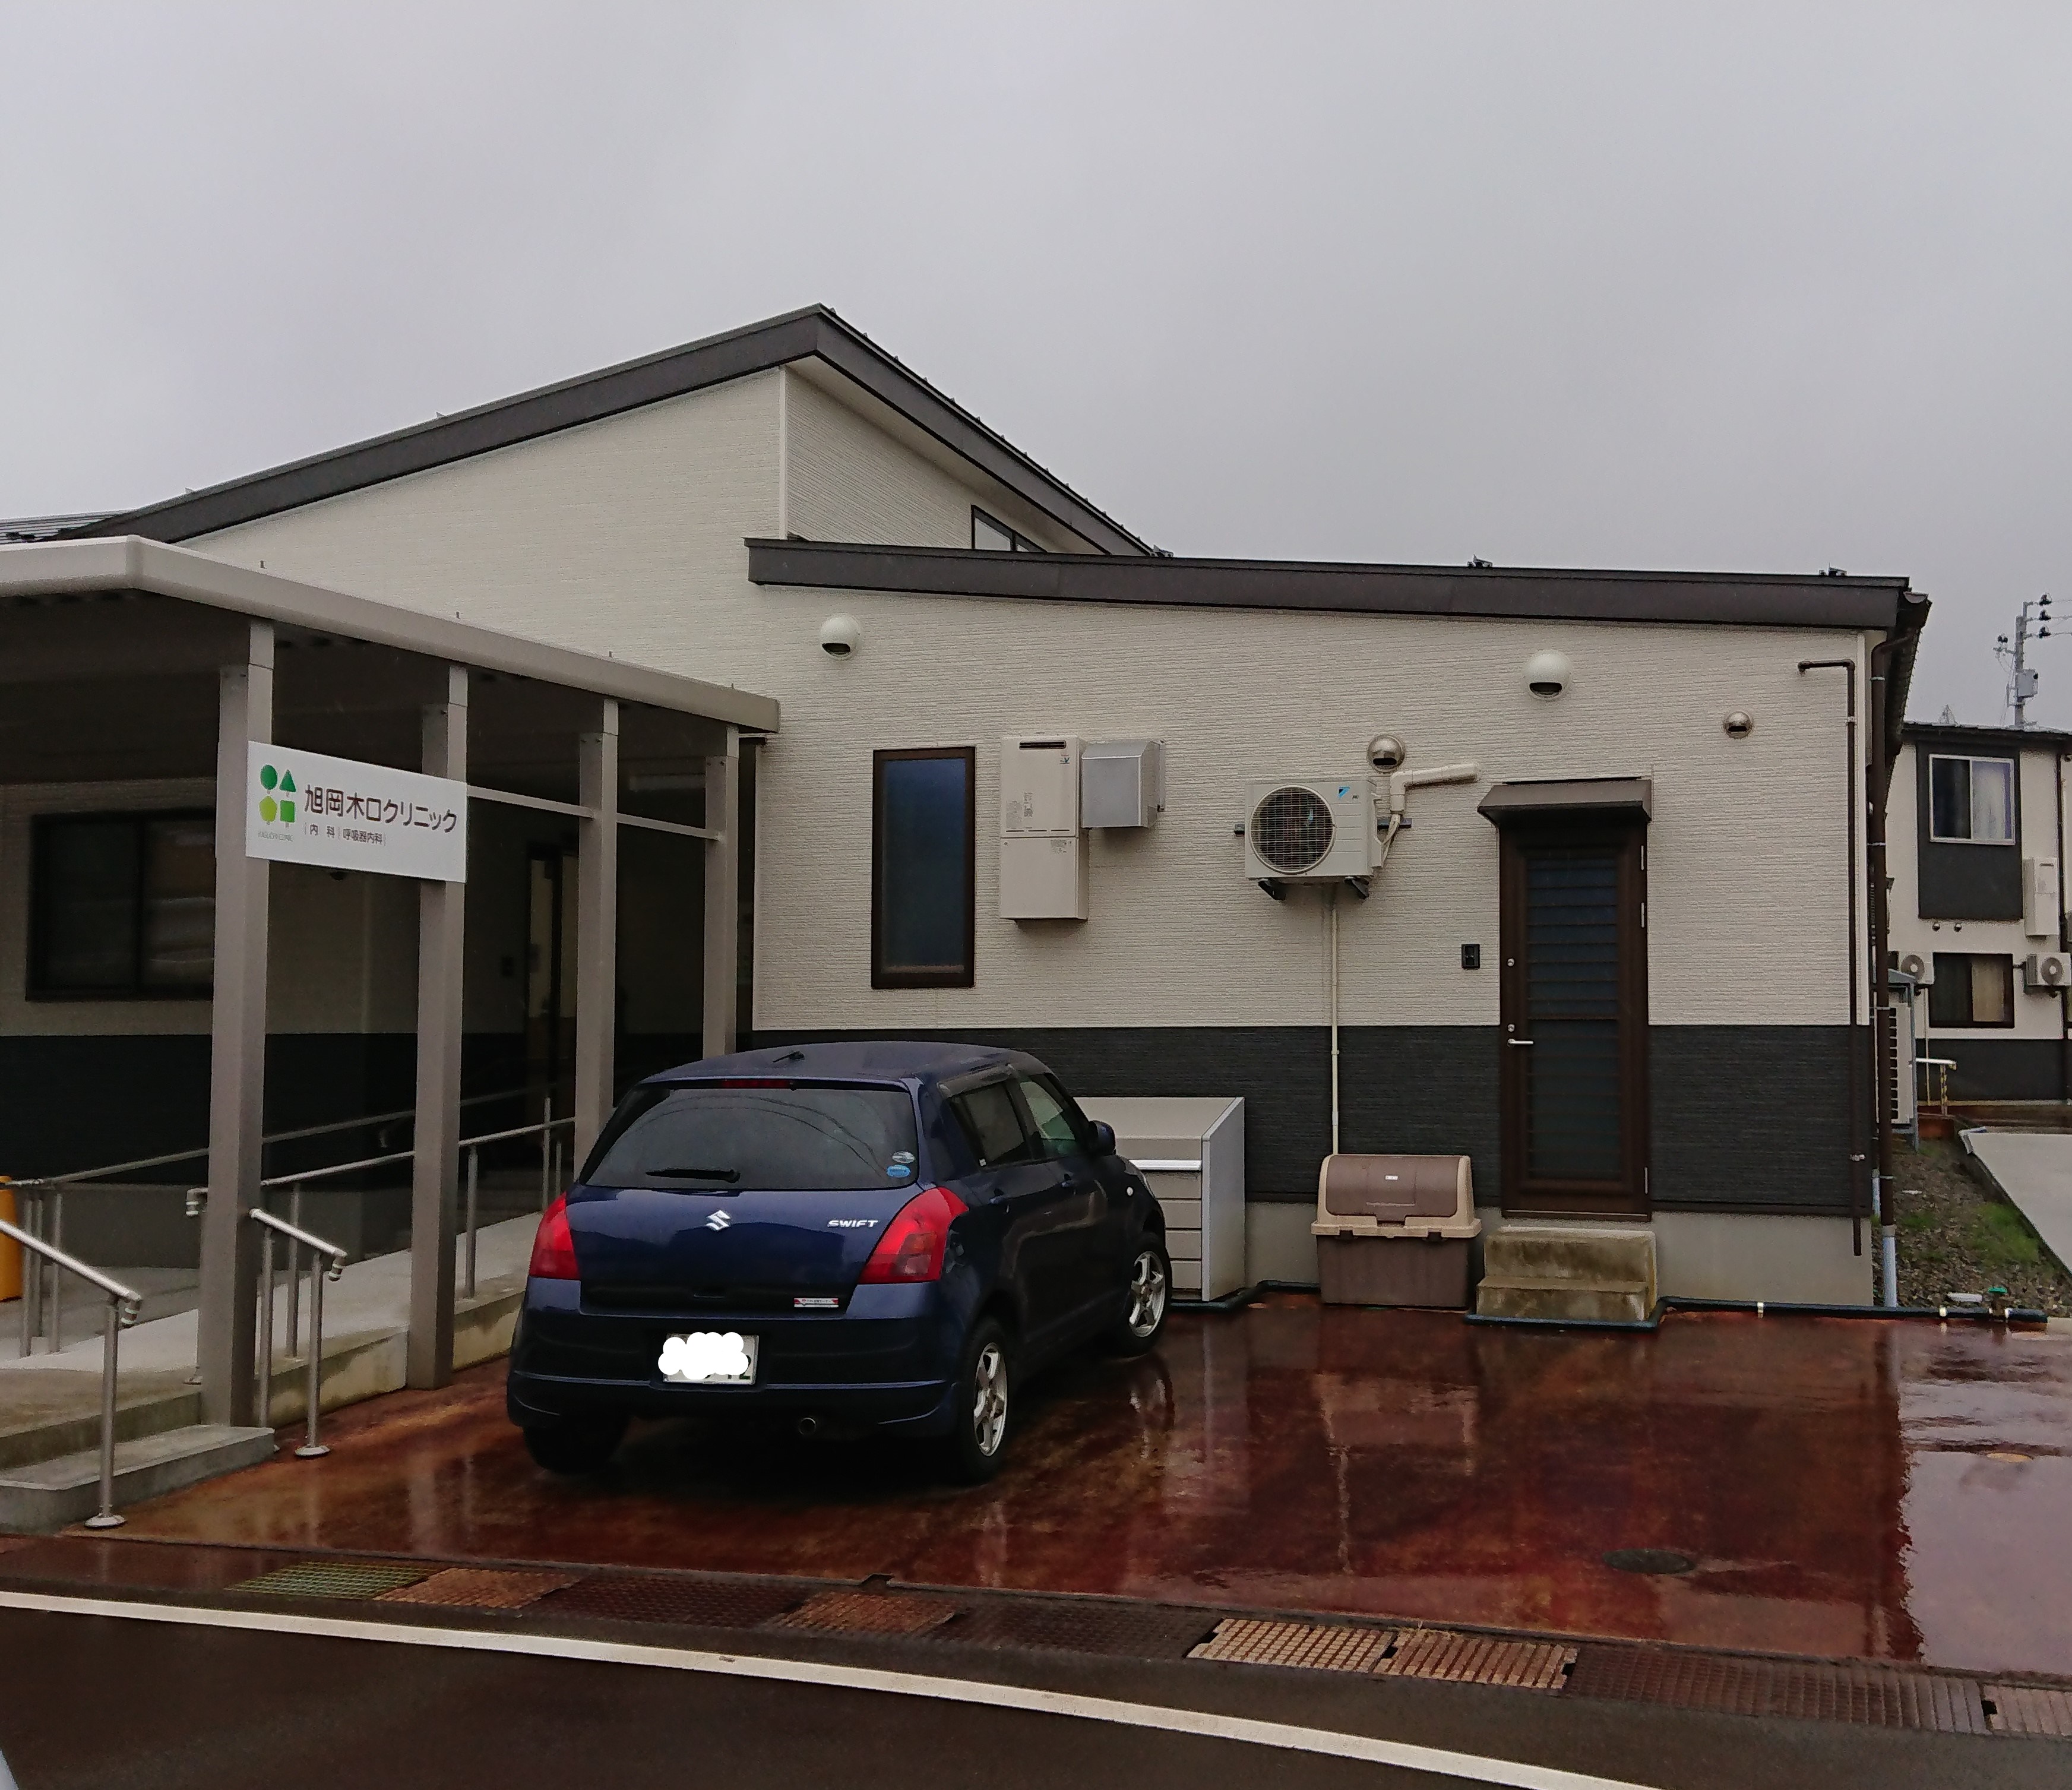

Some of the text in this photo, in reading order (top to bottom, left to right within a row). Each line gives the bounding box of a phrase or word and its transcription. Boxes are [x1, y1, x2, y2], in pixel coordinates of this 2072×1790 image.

[305, 785, 457, 833] 旭岡木口クリニック
[827, 1219, 878, 1228] SWIFT
